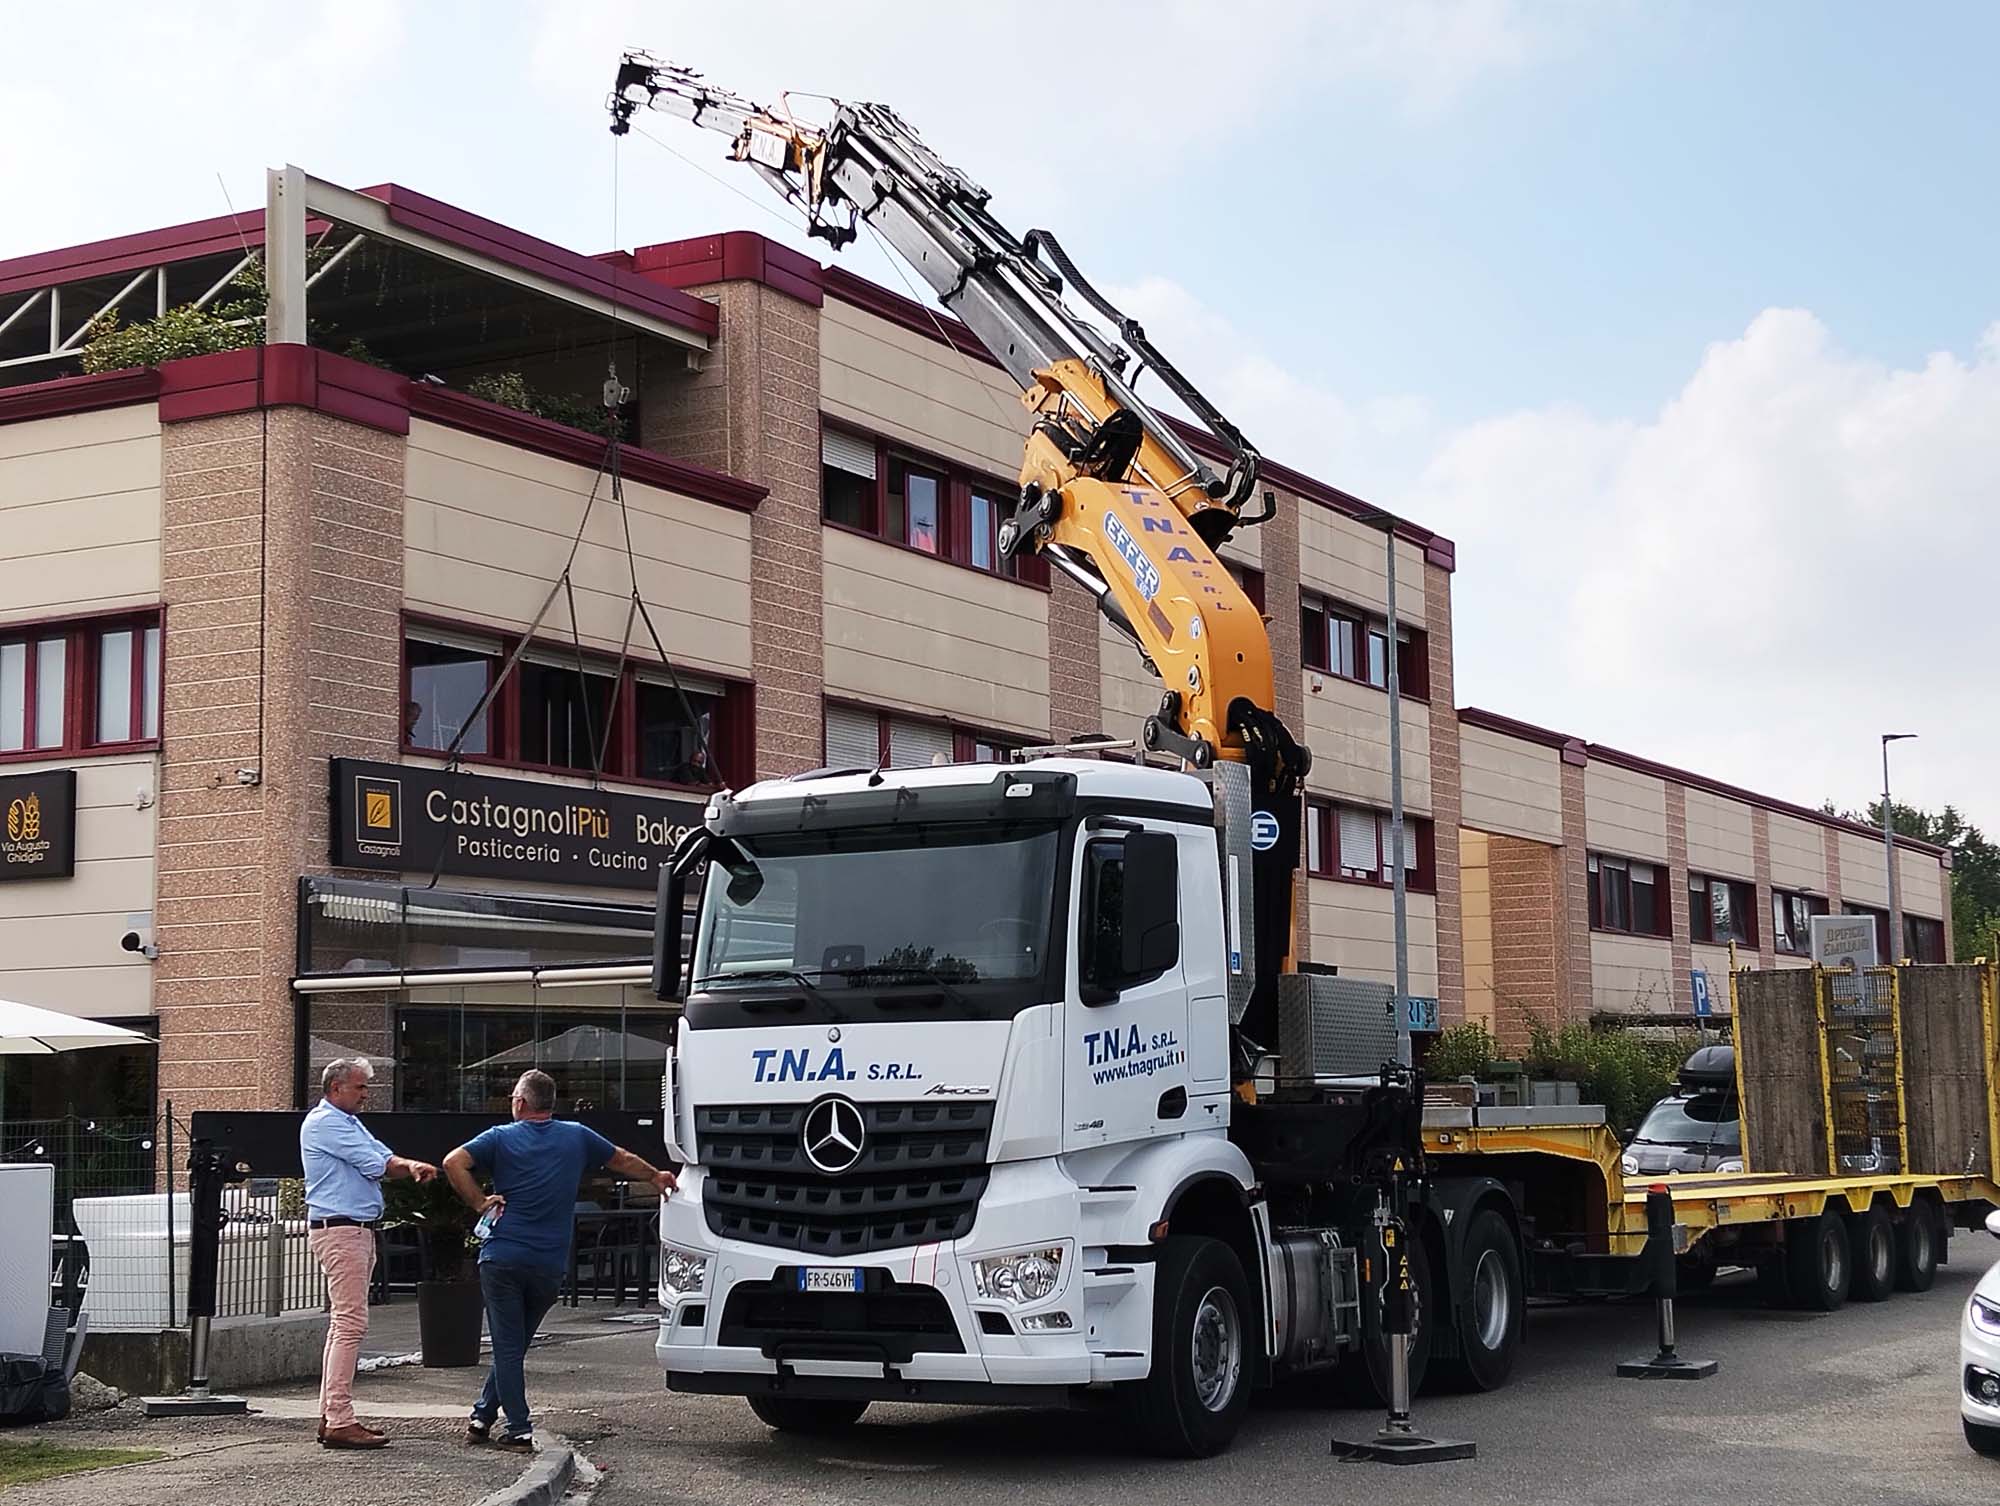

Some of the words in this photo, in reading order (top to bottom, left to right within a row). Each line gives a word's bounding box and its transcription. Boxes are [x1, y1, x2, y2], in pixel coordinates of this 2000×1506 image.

[1106, 515, 1159, 594] EFFER
[426, 790, 610, 839] CastagnoliPiù
[1, 842, 15, 852] Via
[458, 835, 560, 863] Pasticceria
[589, 848, 647, 871] Cucina
[1695, 977, 1706, 1011] P
[1084, 1023, 1147, 1066] T.N.A.
[752, 1047, 857, 1083] T.N.A.
[867, 1063, 922, 1080] S.R.L.
[1093, 1050, 1175, 1086] www.tnagru.it
